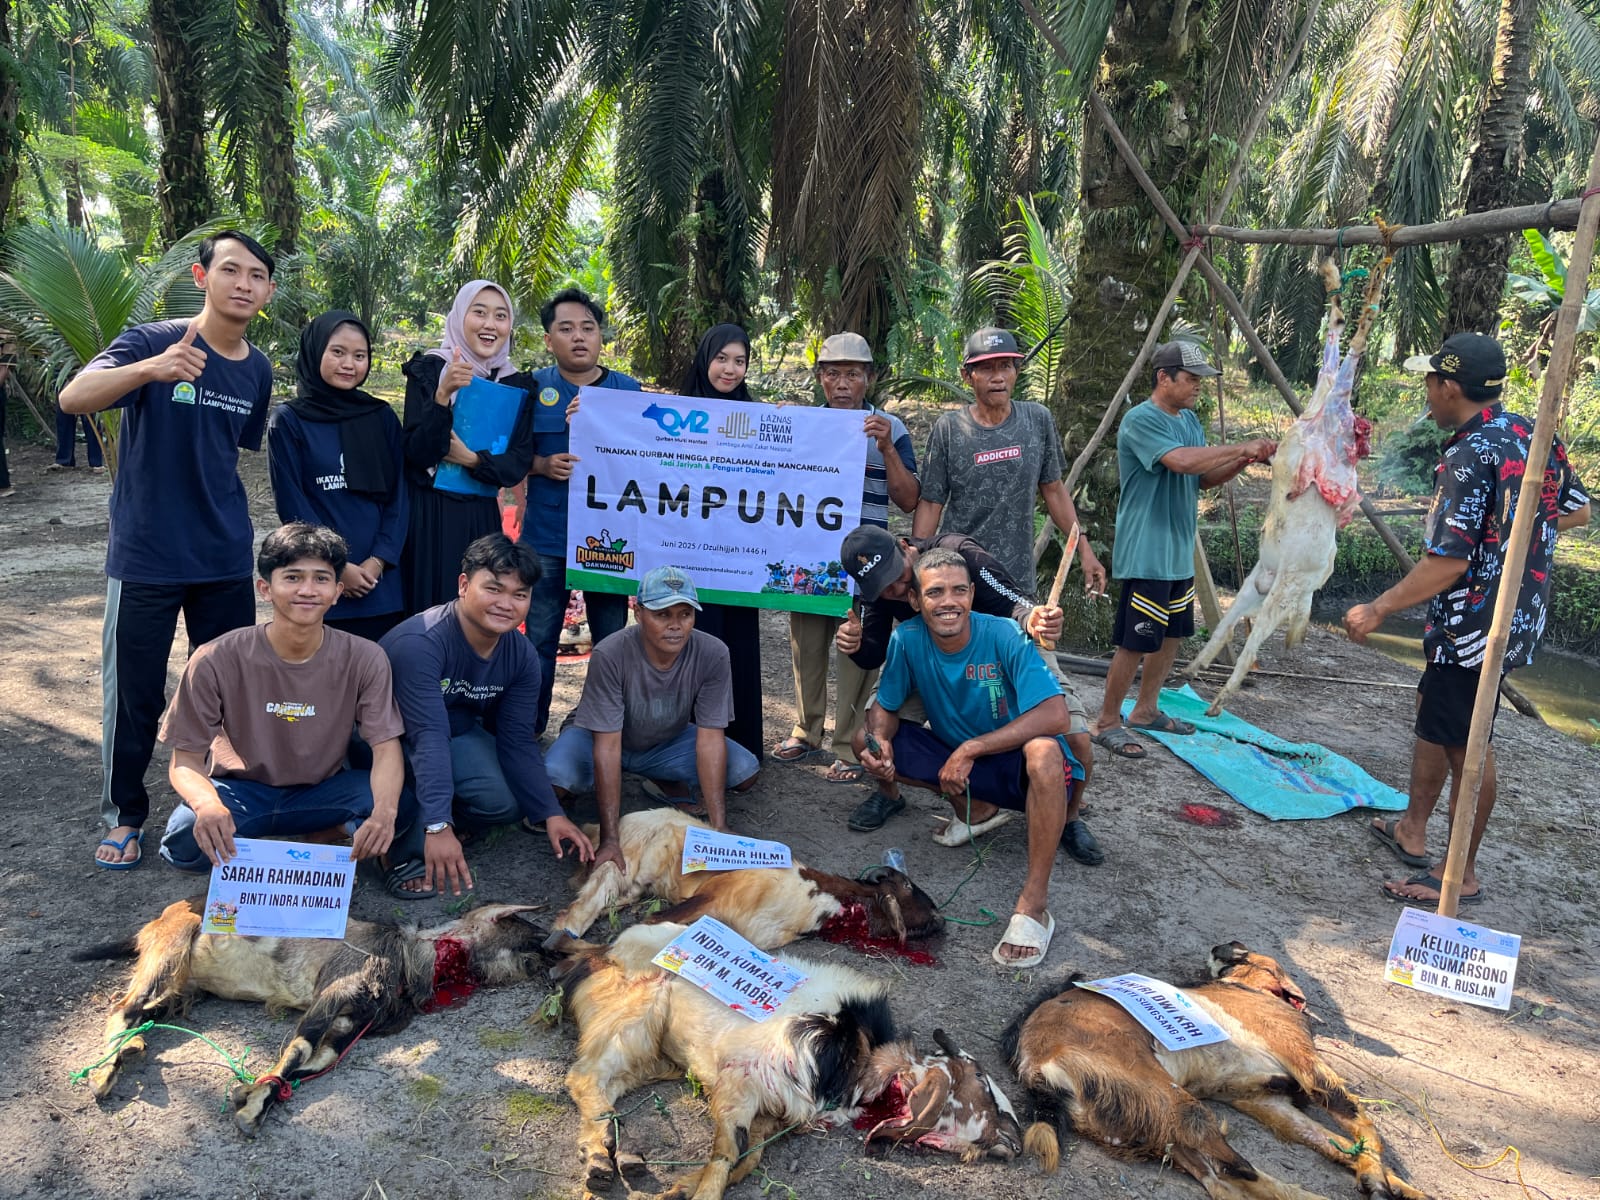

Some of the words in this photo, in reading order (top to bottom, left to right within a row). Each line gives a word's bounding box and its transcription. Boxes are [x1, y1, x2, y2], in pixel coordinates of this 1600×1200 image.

[202, 398, 236, 412] LAMPUNG
[760, 414, 792, 425] LAZNAS
[760, 423, 791, 434] DEWAN
[759, 432, 793, 444] DA'WAH
[595, 446, 637, 456] TUNAIKAN
[639, 450, 674, 460] QURBAN
[676, 454, 708, 462] HINGGA
[710, 455, 760, 466] PEDALAMAN
[762, 460, 776, 468] dan
[778, 462, 840, 474] MANCANEGARA
[977, 448, 1019, 463] ADDICTED
[660, 459, 675, 467] Jadi
[676, 460, 703, 470] Jariyah
[712, 463, 743, 473] Penguat
[746, 466, 775, 475] Dakwah
[316, 475, 345, 484] IKATAN
[586, 474, 844, 531] LAMPUNG
[660, 540, 677, 548] Juni
[678, 541, 696, 550] 2025
[703, 543, 740, 554] Dzulhijjah
[742, 546, 760, 555] 1446
[585, 562, 624, 570] DAKWAHKU
[857, 554, 882, 577] POLO
[693, 844, 746, 858] SAHRIAR
[750, 851, 784, 860] HILMI
[722, 857, 748, 865] INDRA
[221, 865, 264, 884] SARAH
[267, 869, 346, 888] RAHMADIANI
[240, 892, 267, 906] BINTI
[269, 895, 299, 908] INDRA
[301, 896, 341, 910] KUMALA
[1420, 933, 1486, 964] KELUARGA
[691, 931, 730, 958] INDRA
[730, 955, 784, 990] KUMALA
[1404, 945, 1428, 965] KUS
[1431, 953, 1508, 984] SUMARSONO
[693, 953, 717, 972] BIN
[715, 967, 730, 983] M.
[732, 977, 773, 1005] KADRI
[1420, 970, 1439, 986] BIN
[1441, 976, 1451, 989] R.
[1455, 978, 1496, 999] RUSLAN
[1136, 997, 1179, 1036] SUNGSANG
[1151, 994, 1179, 1014] DWI
[1174, 1015, 1203, 1037] KRH
